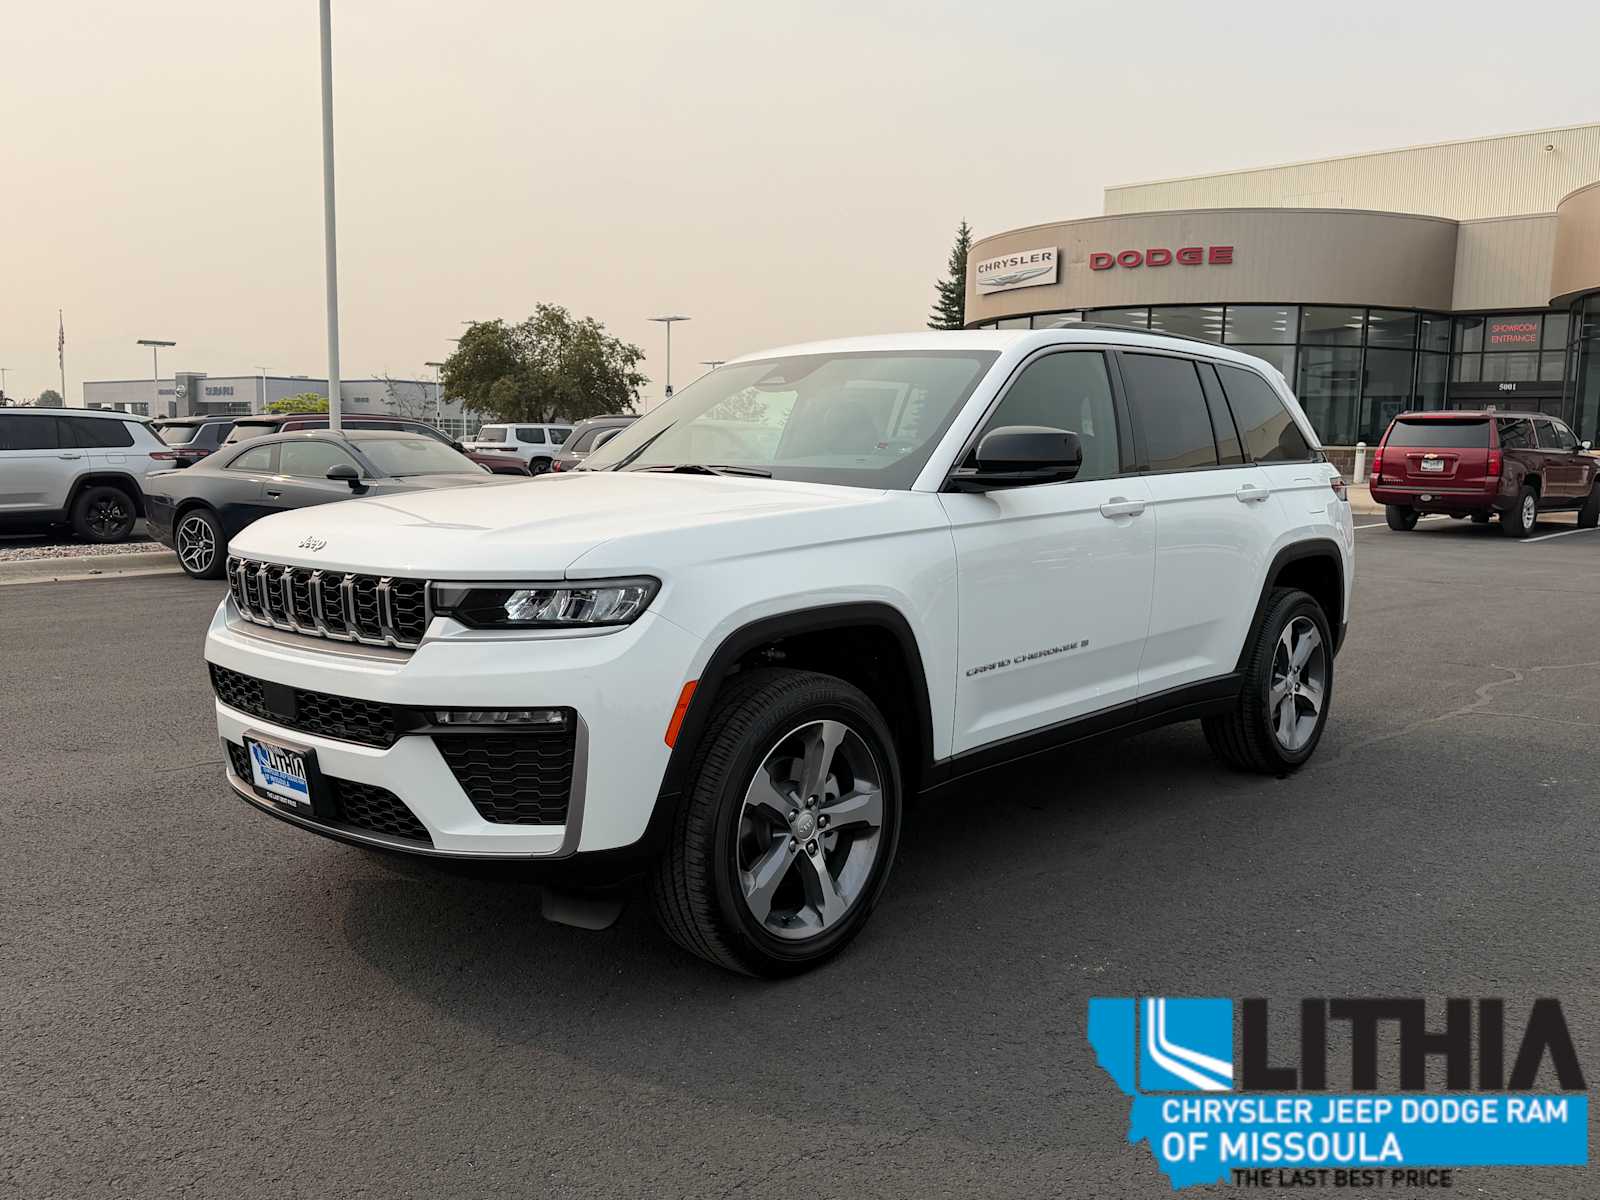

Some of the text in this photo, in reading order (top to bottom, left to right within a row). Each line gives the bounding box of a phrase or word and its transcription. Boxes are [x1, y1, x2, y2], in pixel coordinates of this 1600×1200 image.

[978, 252, 1052, 273] CHRYSLER
[1090, 246, 1234, 271] DODGE
[1491, 323, 1537, 333] SHOWROOM
[1491, 334, 1536, 344] ENTRANCE
[1498, 383, 1517, 391] 5001
[297, 536, 328, 552] Jeep
[966, 642, 1078, 677] GRAND CHEROKEE
[267, 748, 306, 779] LITHIA
